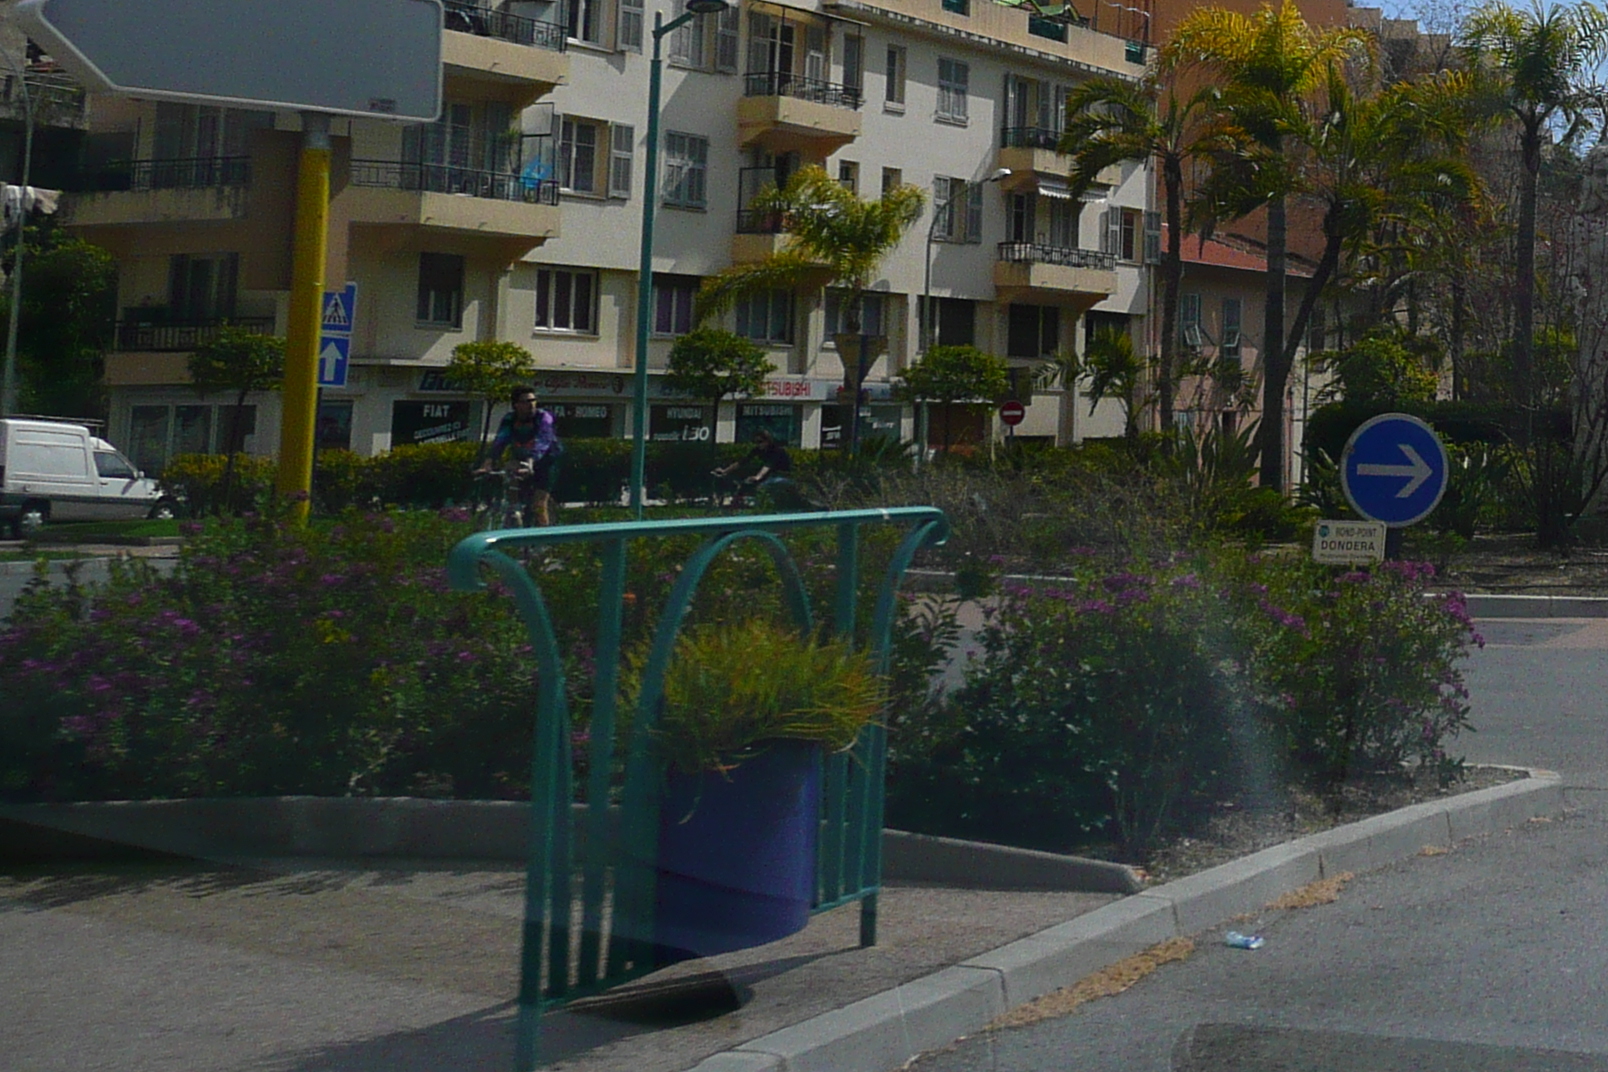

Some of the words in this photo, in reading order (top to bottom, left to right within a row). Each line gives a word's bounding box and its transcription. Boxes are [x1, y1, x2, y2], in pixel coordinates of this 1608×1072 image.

[423, 404, 450, 418] FIAT
[575, 405, 607, 418] ROMEO
[667, 407, 702, 419] HYUNDAI
[742, 405, 794, 416] MITSUBISHI
[682, 425, 709, 440] i30
[1320, 540, 1375, 551] DONDERA
